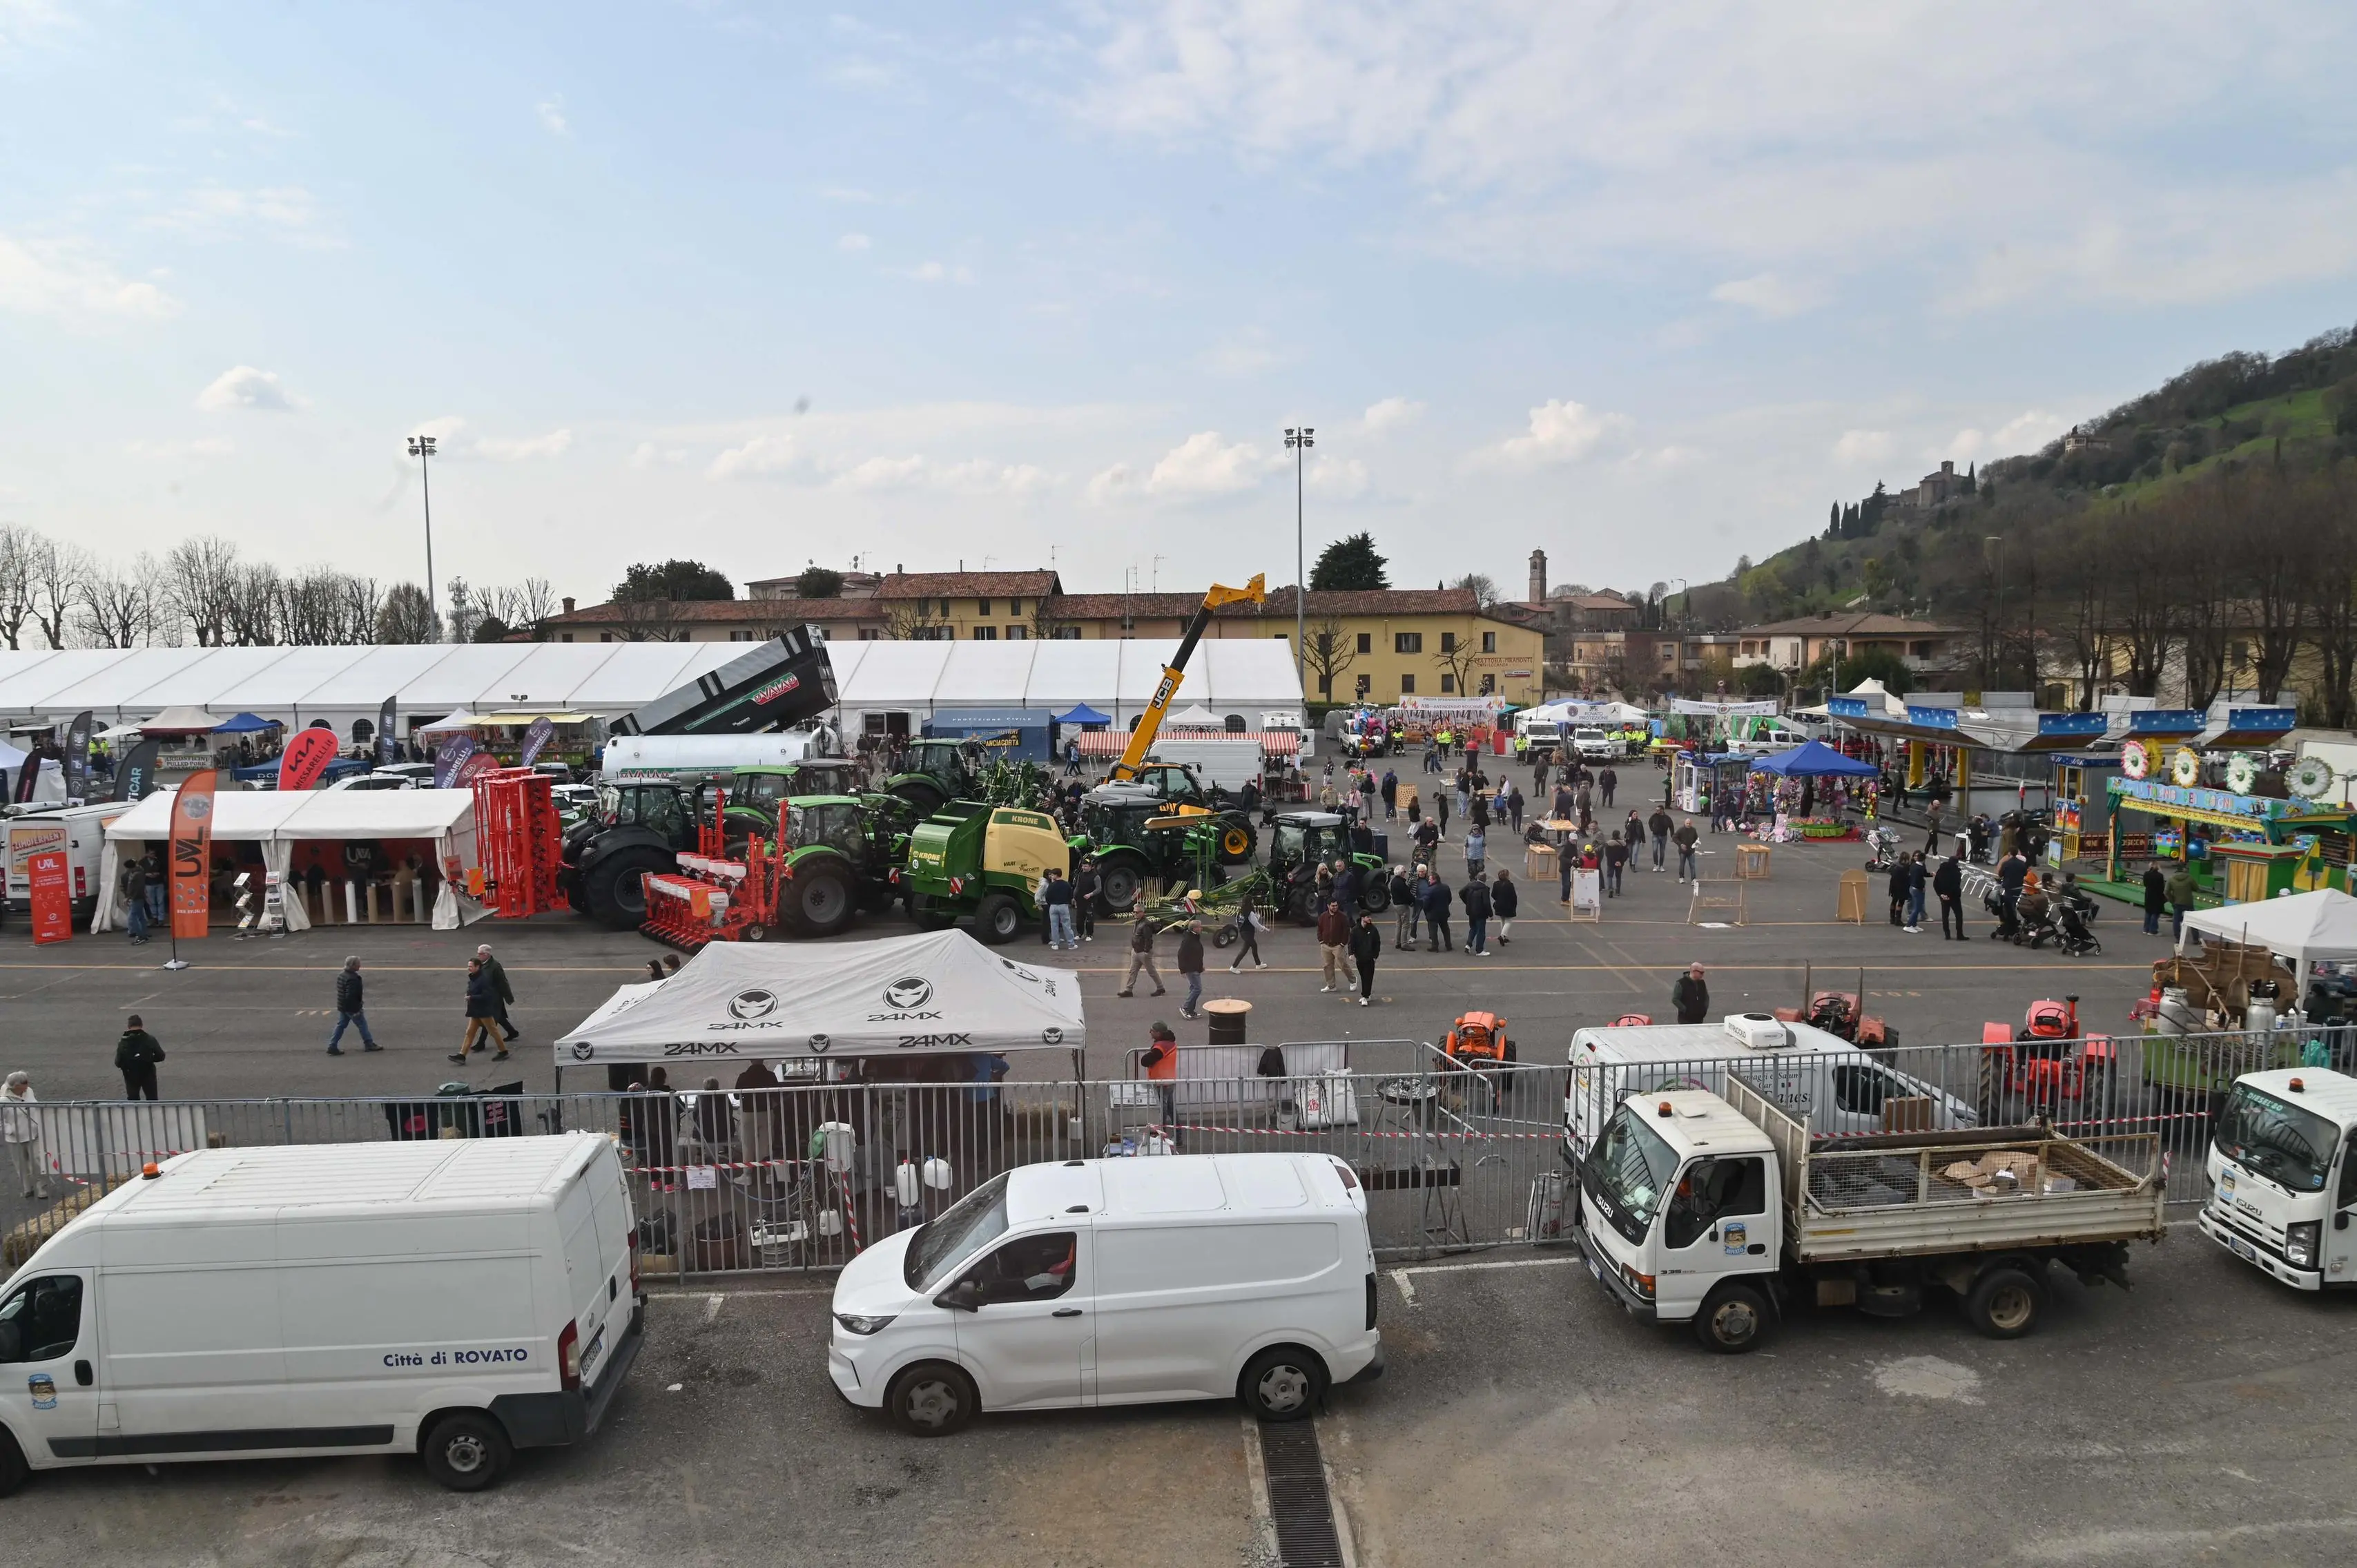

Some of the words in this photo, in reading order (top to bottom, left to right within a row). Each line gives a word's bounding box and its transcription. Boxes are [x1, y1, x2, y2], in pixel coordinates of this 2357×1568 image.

[760, 679, 790, 699] VAIA
[1154, 678, 1174, 709] JCB
[289, 737, 315, 773] KIA
[464, 765, 476, 776] KIA
[2147, 785, 2177, 801] TRENO
[2182, 791, 2198, 804] DEI
[1011, 815, 1038, 825] KRONE
[175, 826, 204, 878] UVL
[918, 852, 941, 861] KRONE
[706, 1020, 784, 1030] 24MX
[867, 1011, 944, 1022] 24MX
[663, 1041, 739, 1056] 24MX
[899, 1033, 973, 1048] 24MX
[1595, 1193, 1614, 1219] ISUZU
[2235, 1197, 2262, 1217] ISUZU
[383, 1353, 423, 1367] Città
[430, 1351, 447, 1365] di
[454, 1348, 528, 1364] ROVATO
